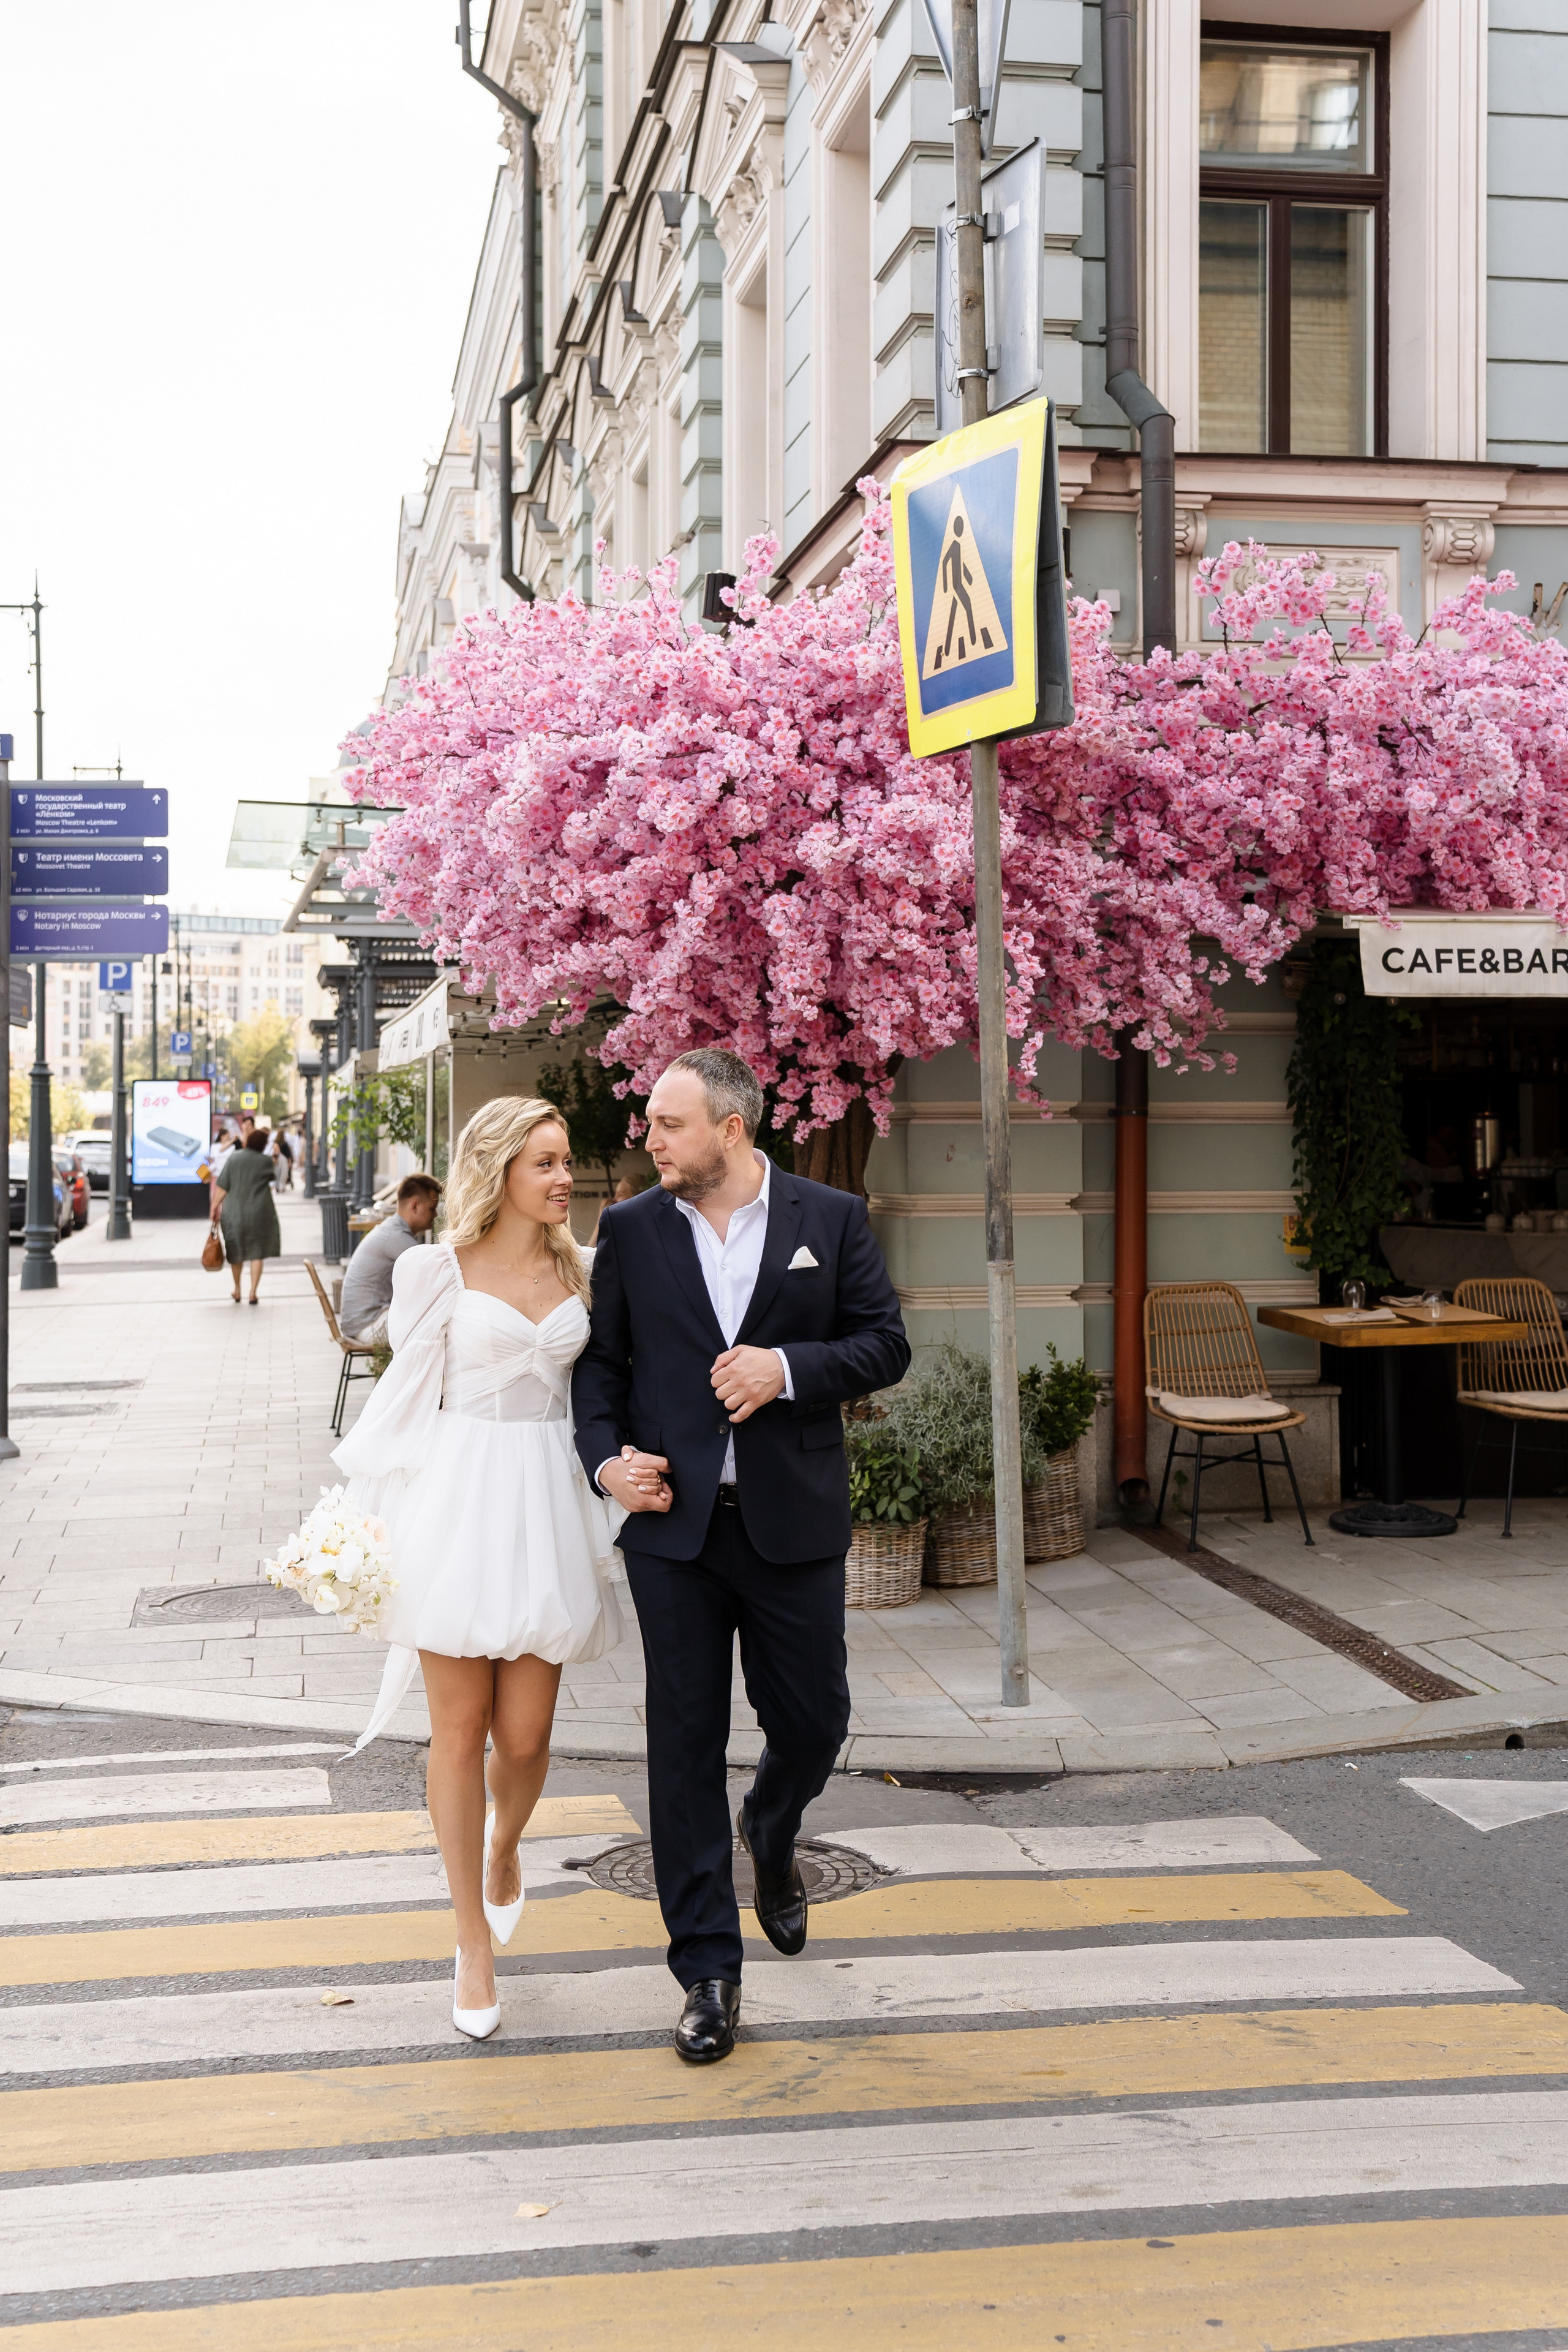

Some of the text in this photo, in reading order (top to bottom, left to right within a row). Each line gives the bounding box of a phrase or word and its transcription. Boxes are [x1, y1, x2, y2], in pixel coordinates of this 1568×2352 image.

[35, 802, 104, 811] государственный
[36, 853, 62, 863] Театр
[96, 853, 143, 861] Моссовета
[34, 911, 77, 921] Нотариус
[78, 912, 109, 921] города
[34, 922, 61, 932] Notary
[1381, 947, 1568, 974] CAFE&BAR
[107, 962, 128, 988] P
[175, 1035, 189, 1052] P
